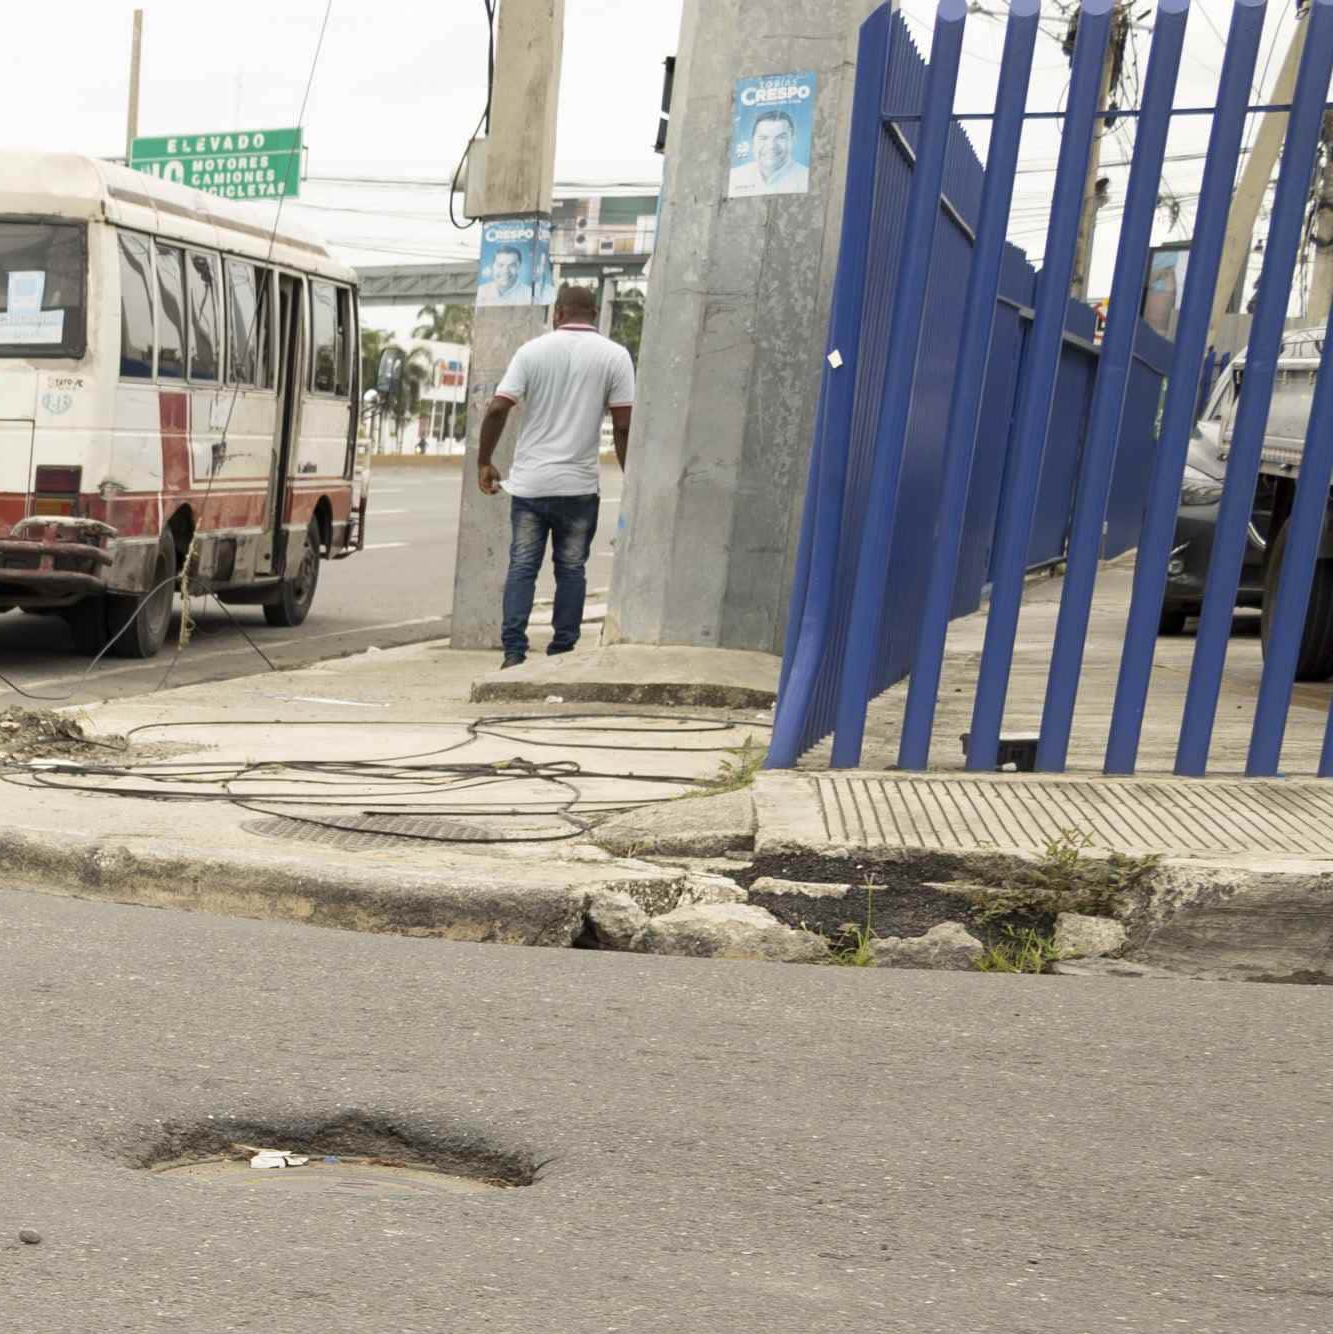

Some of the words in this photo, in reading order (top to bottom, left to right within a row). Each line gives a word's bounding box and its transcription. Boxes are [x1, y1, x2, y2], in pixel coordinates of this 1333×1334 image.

[741, 86, 811, 106] CRESPO
[166, 133, 265, 153] ELEVADO
[191, 156, 269, 172] MOTORES
[191, 170, 275, 185] CAMIONES
[485, 228, 534, 242] CRESPO
